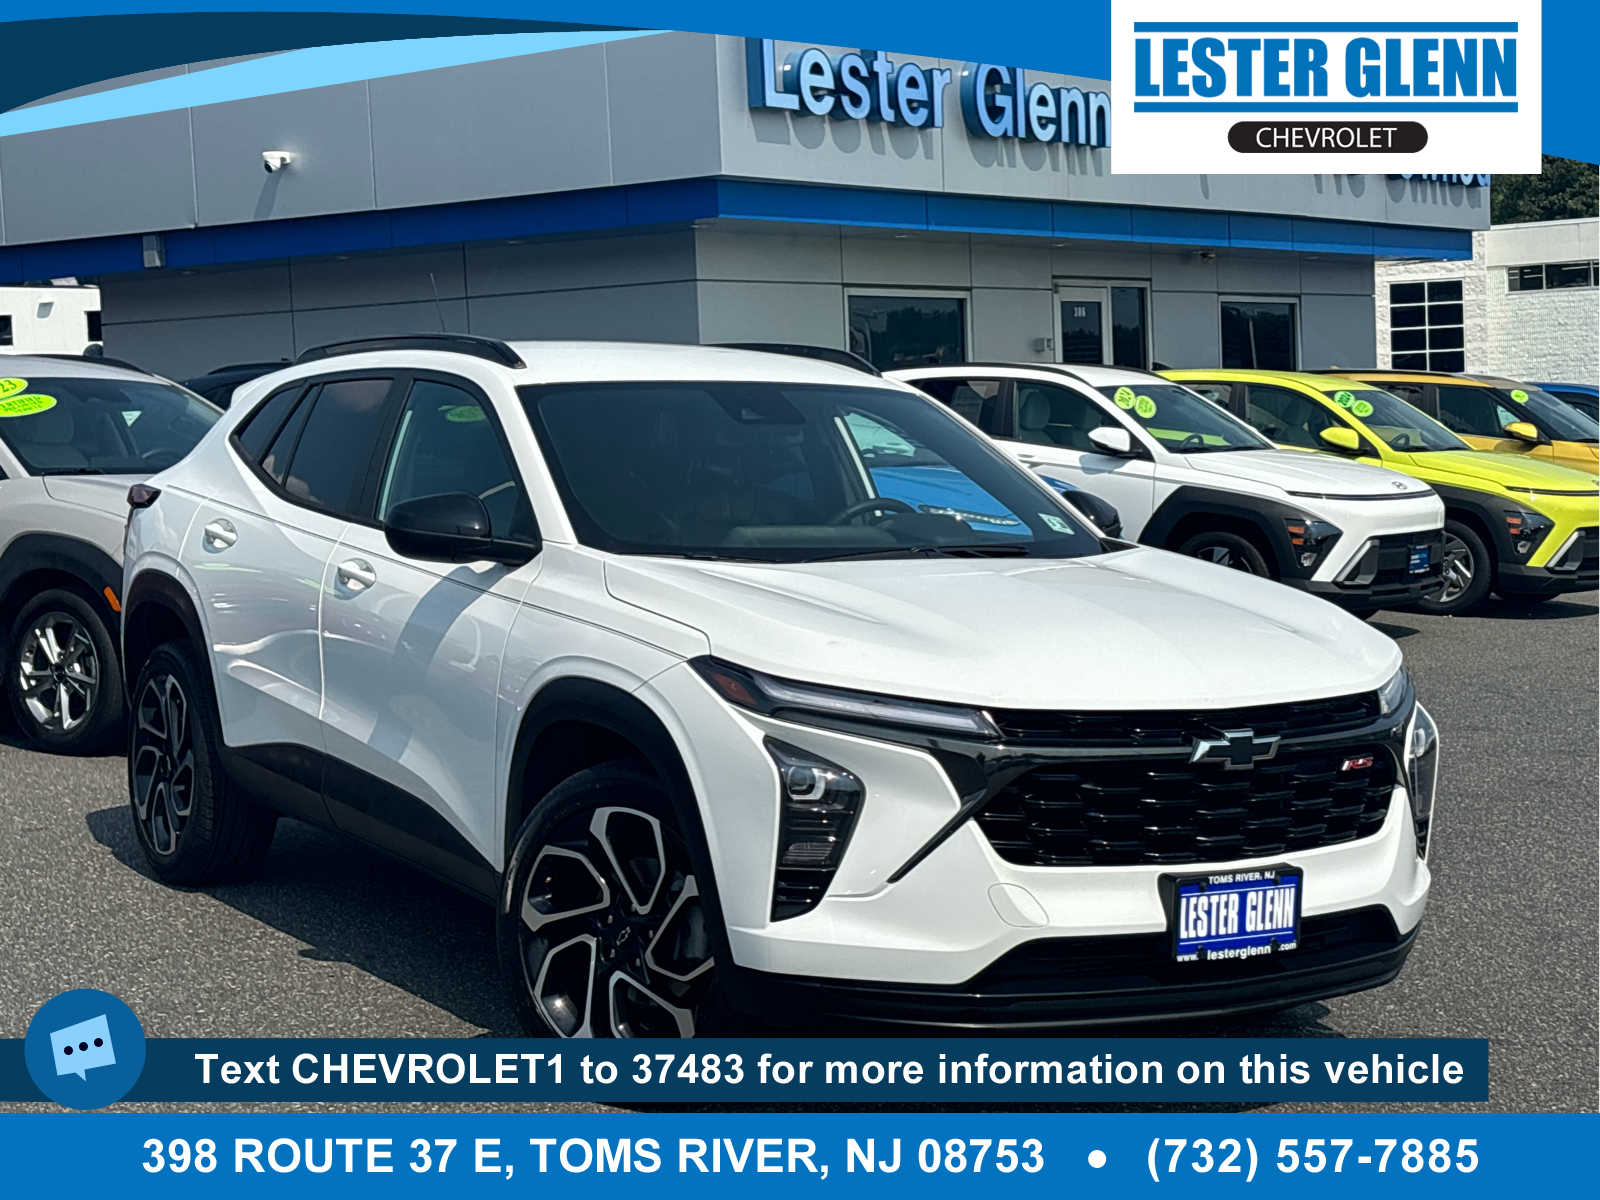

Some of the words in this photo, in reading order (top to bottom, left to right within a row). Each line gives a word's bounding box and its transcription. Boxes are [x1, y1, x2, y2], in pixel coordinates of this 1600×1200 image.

[746, 38, 952, 128] Lester
[960, 62, 1111, 148] Glenn
[1342, 756, 1374, 771] RS
[1208, 874, 1234, 885] TOMS
[1264, 870, 1276, 880] NJ
[1179, 892, 1240, 940] LESTER
[1245, 887, 1296, 932] GLENN
